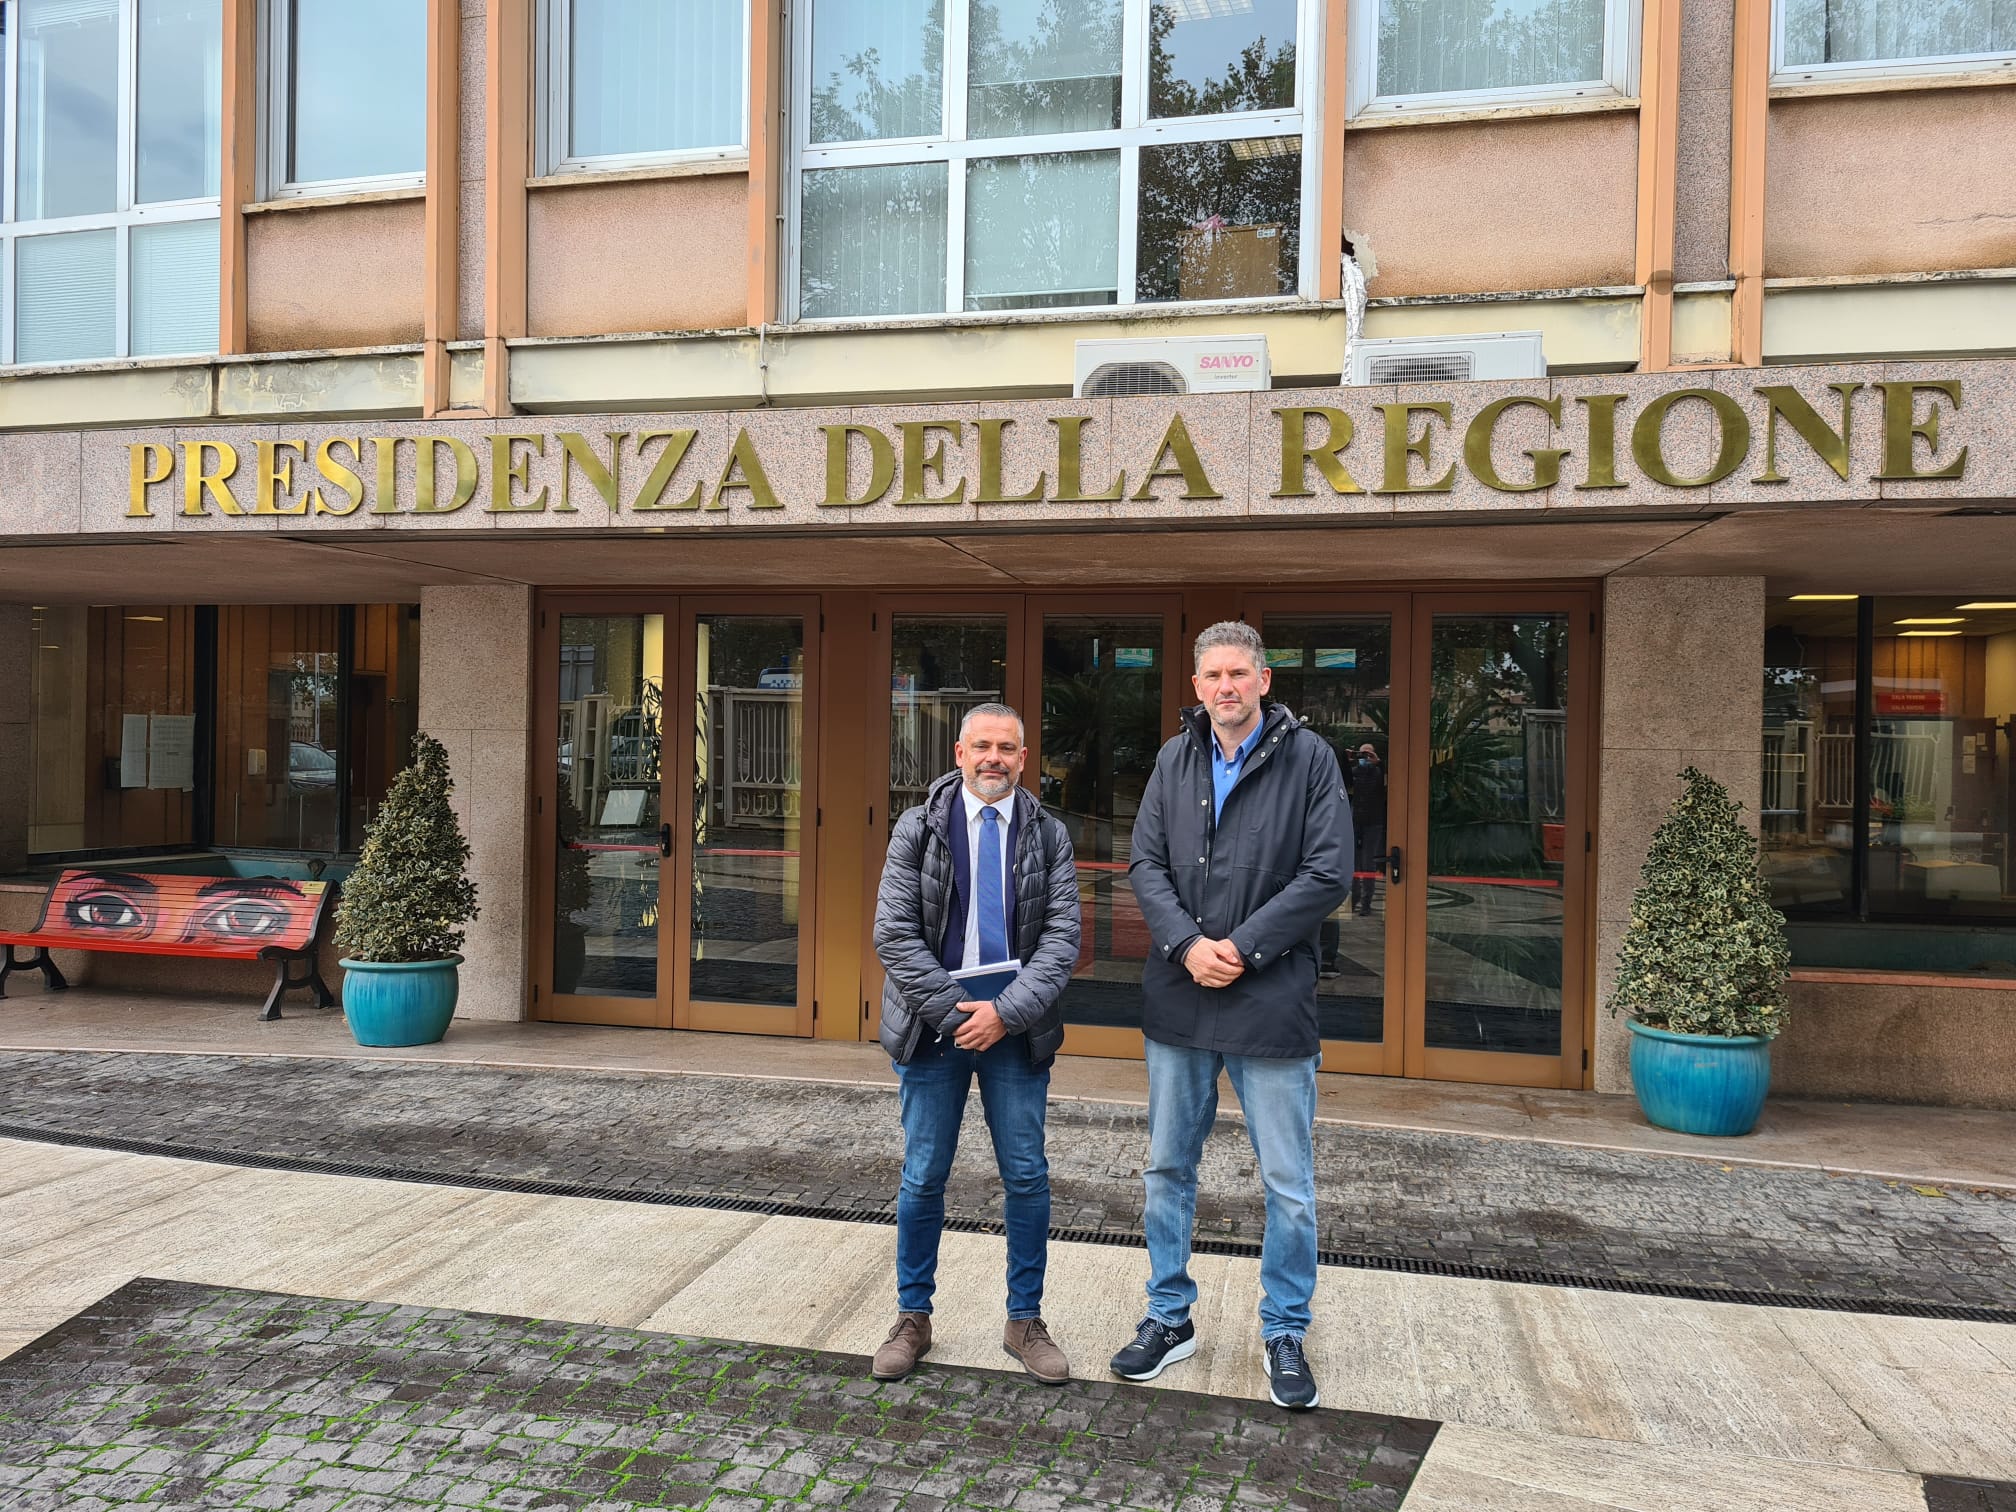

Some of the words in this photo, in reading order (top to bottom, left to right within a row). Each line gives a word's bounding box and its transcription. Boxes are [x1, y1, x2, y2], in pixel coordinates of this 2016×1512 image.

[1200, 354, 1254, 369] SANYO
[124, 427, 786, 518] PRESIDENZA
[818, 410, 1223, 508] DELLA
[1270, 379, 1969, 497] REGIONE
